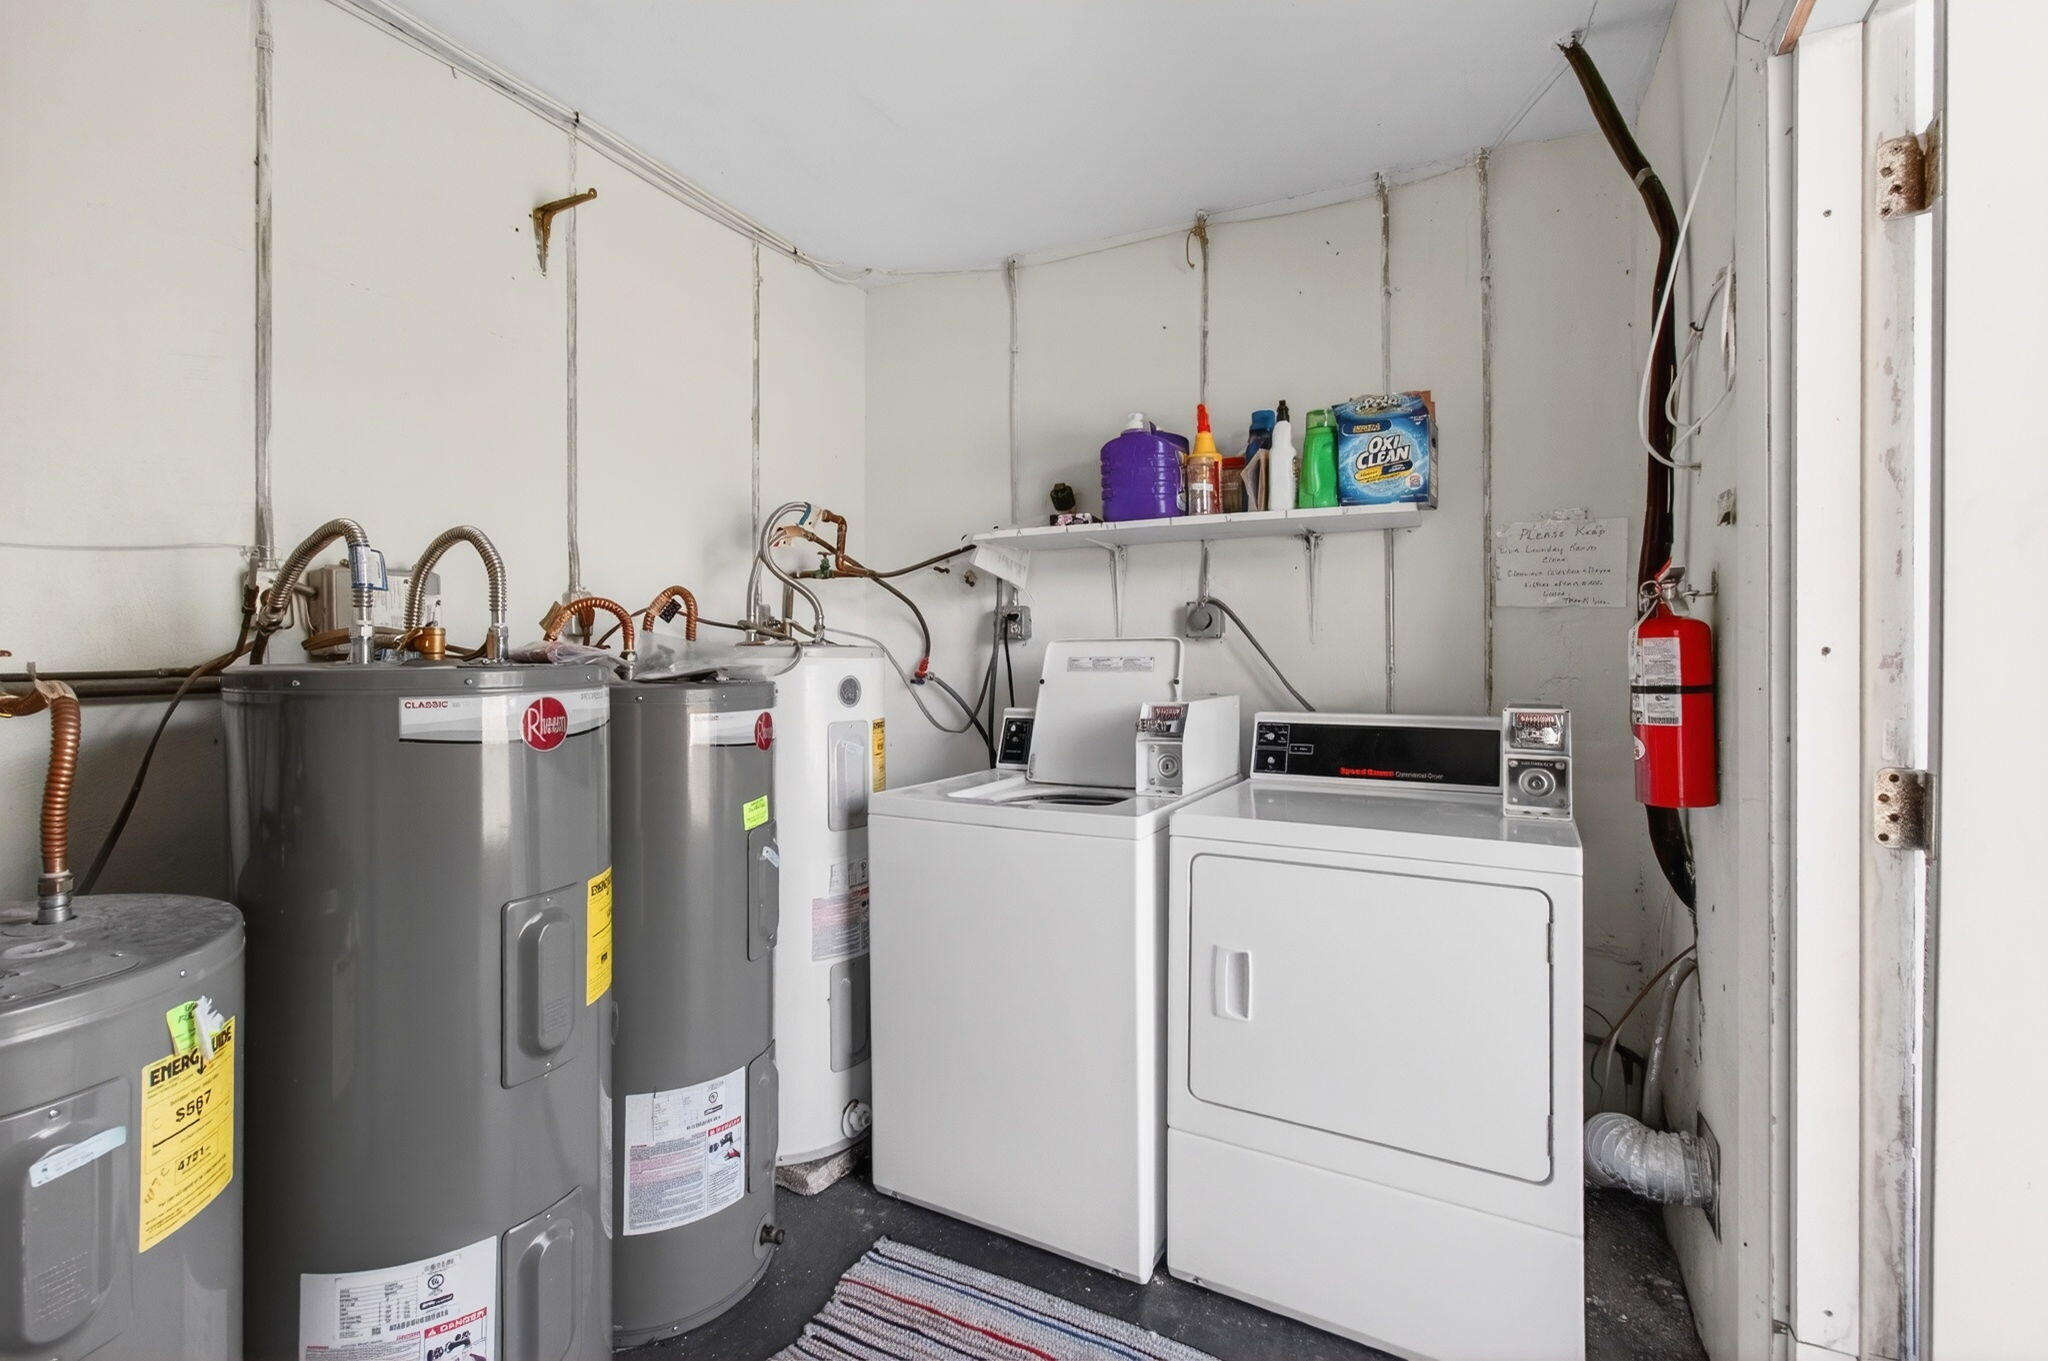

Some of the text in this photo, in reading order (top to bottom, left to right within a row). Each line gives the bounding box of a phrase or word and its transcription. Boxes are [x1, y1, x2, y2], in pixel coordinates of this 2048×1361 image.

[1367, 434, 1401, 454] OXI
[1355, 444, 1411, 470] CLEAN
[404, 700, 449, 710] CLASSIC
